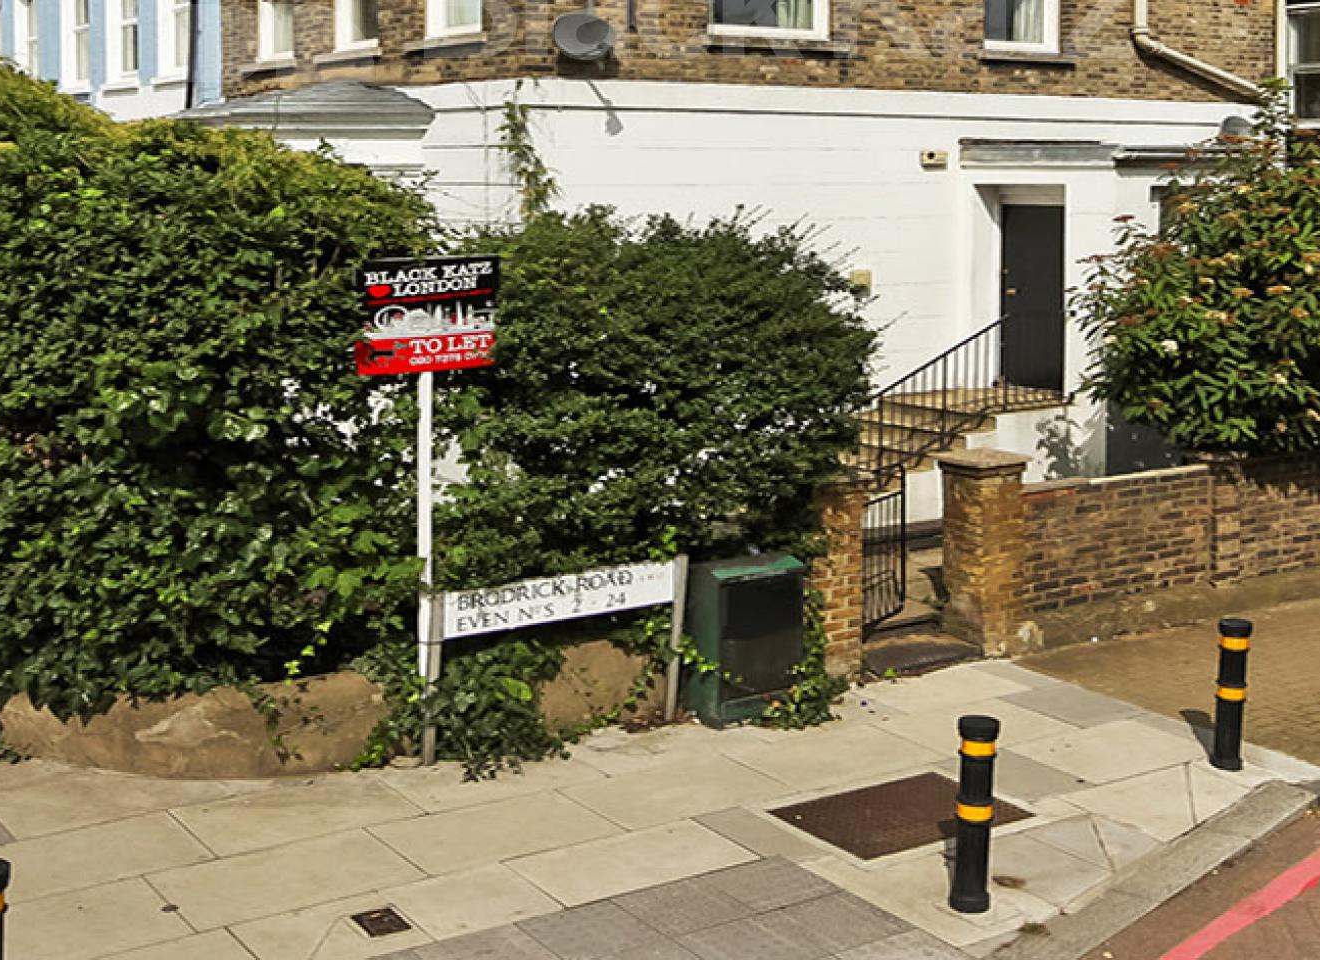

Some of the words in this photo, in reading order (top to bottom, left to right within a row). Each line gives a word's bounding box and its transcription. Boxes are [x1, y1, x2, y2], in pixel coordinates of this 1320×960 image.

[364, 267, 437, 286] BLACK
[442, 261, 493, 279] KATZ
[392, 276, 478, 297] LONDON
[409, 338, 443, 355] TO
[446, 334, 493, 352] LET
[456, 575, 566, 612] BRODRICK
[576, 569, 634, 593] ROAD
[456, 609, 510, 632] EVEN
[572, 597, 582, 614] 2
[606, 591, 627, 608] 24
